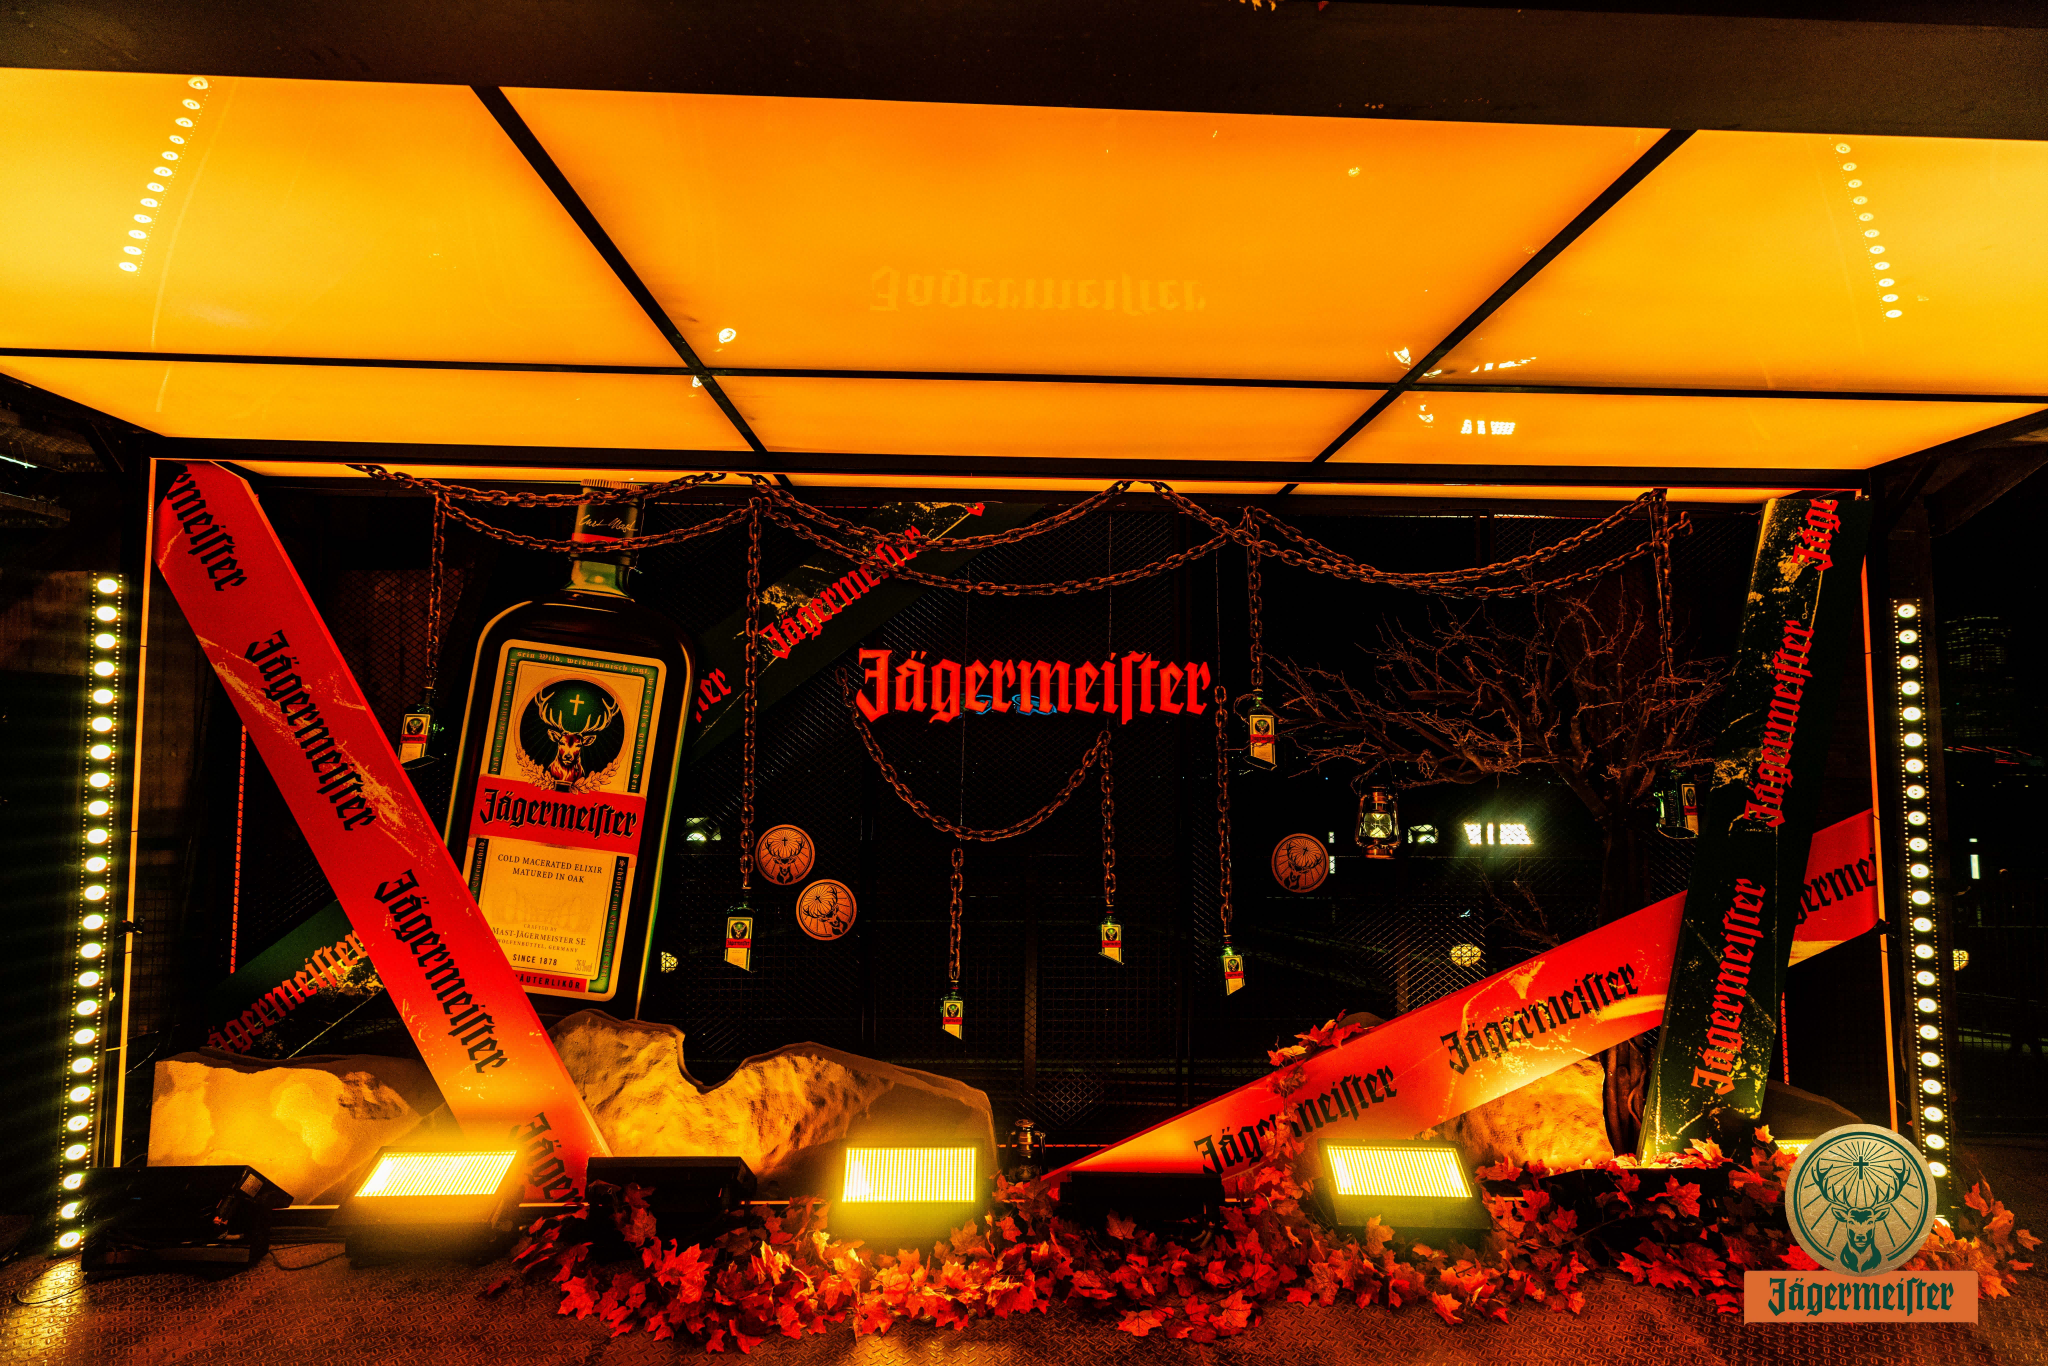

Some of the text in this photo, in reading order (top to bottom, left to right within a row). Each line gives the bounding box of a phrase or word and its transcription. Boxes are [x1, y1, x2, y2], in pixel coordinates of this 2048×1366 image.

[856, 648, 1211, 725] Jägermeister
[1743, 619, 1814, 828] Jägermeister
[244, 629, 376, 831] Jägermeister
[479, 788, 638, 840] Jägermeister
[497, 854, 603, 874] COLD MACERATED ELIXIR
[512, 867, 585, 884] MATURED IN OAK
[374, 869, 508, 1073] Jägermeister
[512, 953, 558, 967] SINCE 1878
[575, 937, 587, 946] SE
[207, 930, 368, 1054] ägermeister
[514, 973, 581, 989] ÄUTERLIKÖR
[1440, 963, 1639, 1075] Jägermeister
[1691, 878, 1766, 1095] Jägermeister
